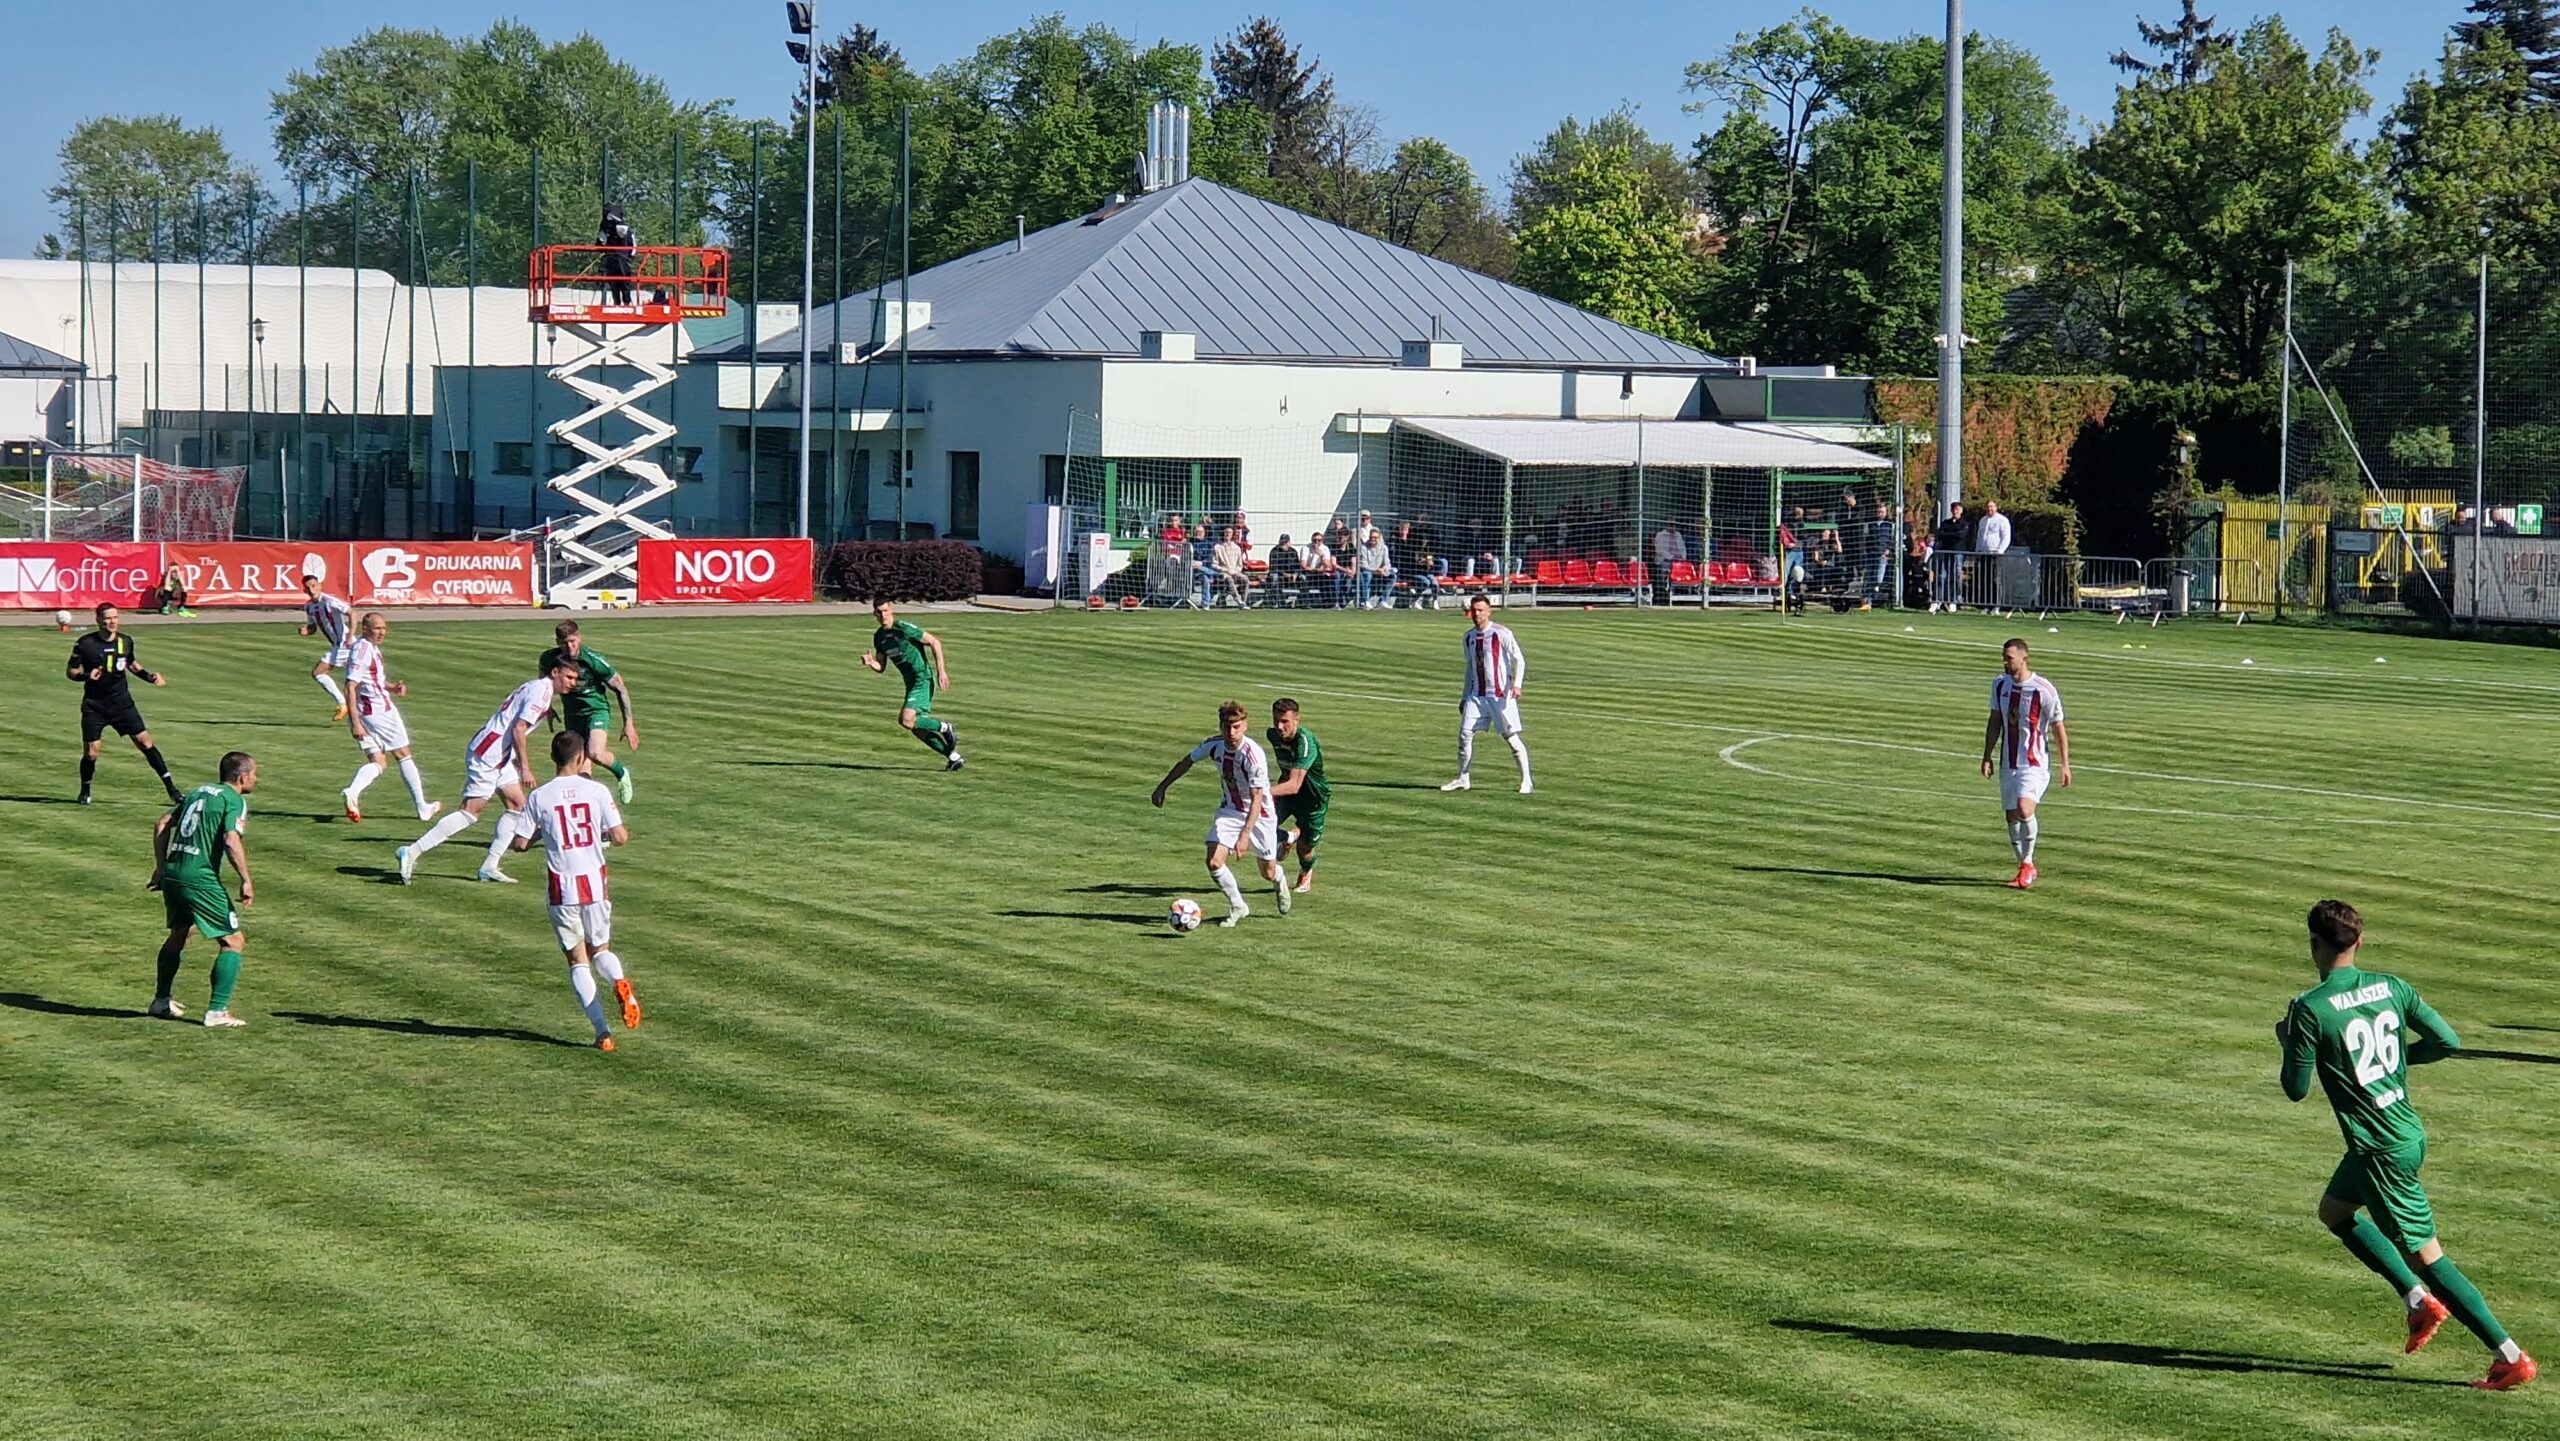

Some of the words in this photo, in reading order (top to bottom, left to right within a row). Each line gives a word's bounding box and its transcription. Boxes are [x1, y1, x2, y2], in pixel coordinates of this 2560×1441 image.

[199, 556, 219, 567] The
[424, 556, 522, 571] DRUKARNIA
[675, 549, 776, 583] NO10
[184, 564, 299, 592] PARK
[432, 579, 513, 595] CYFROWA
[373, 588, 415, 599] PRINT
[675, 586, 722, 595] SPORTS
[562, 789, 576, 799] LIS
[181, 799, 204, 837] 6
[554, 803, 594, 850] 13
[229, 911, 239, 929] 6
[2328, 981, 2393, 1011] WALASZEK
[2346, 1010, 2400, 1087] 26
